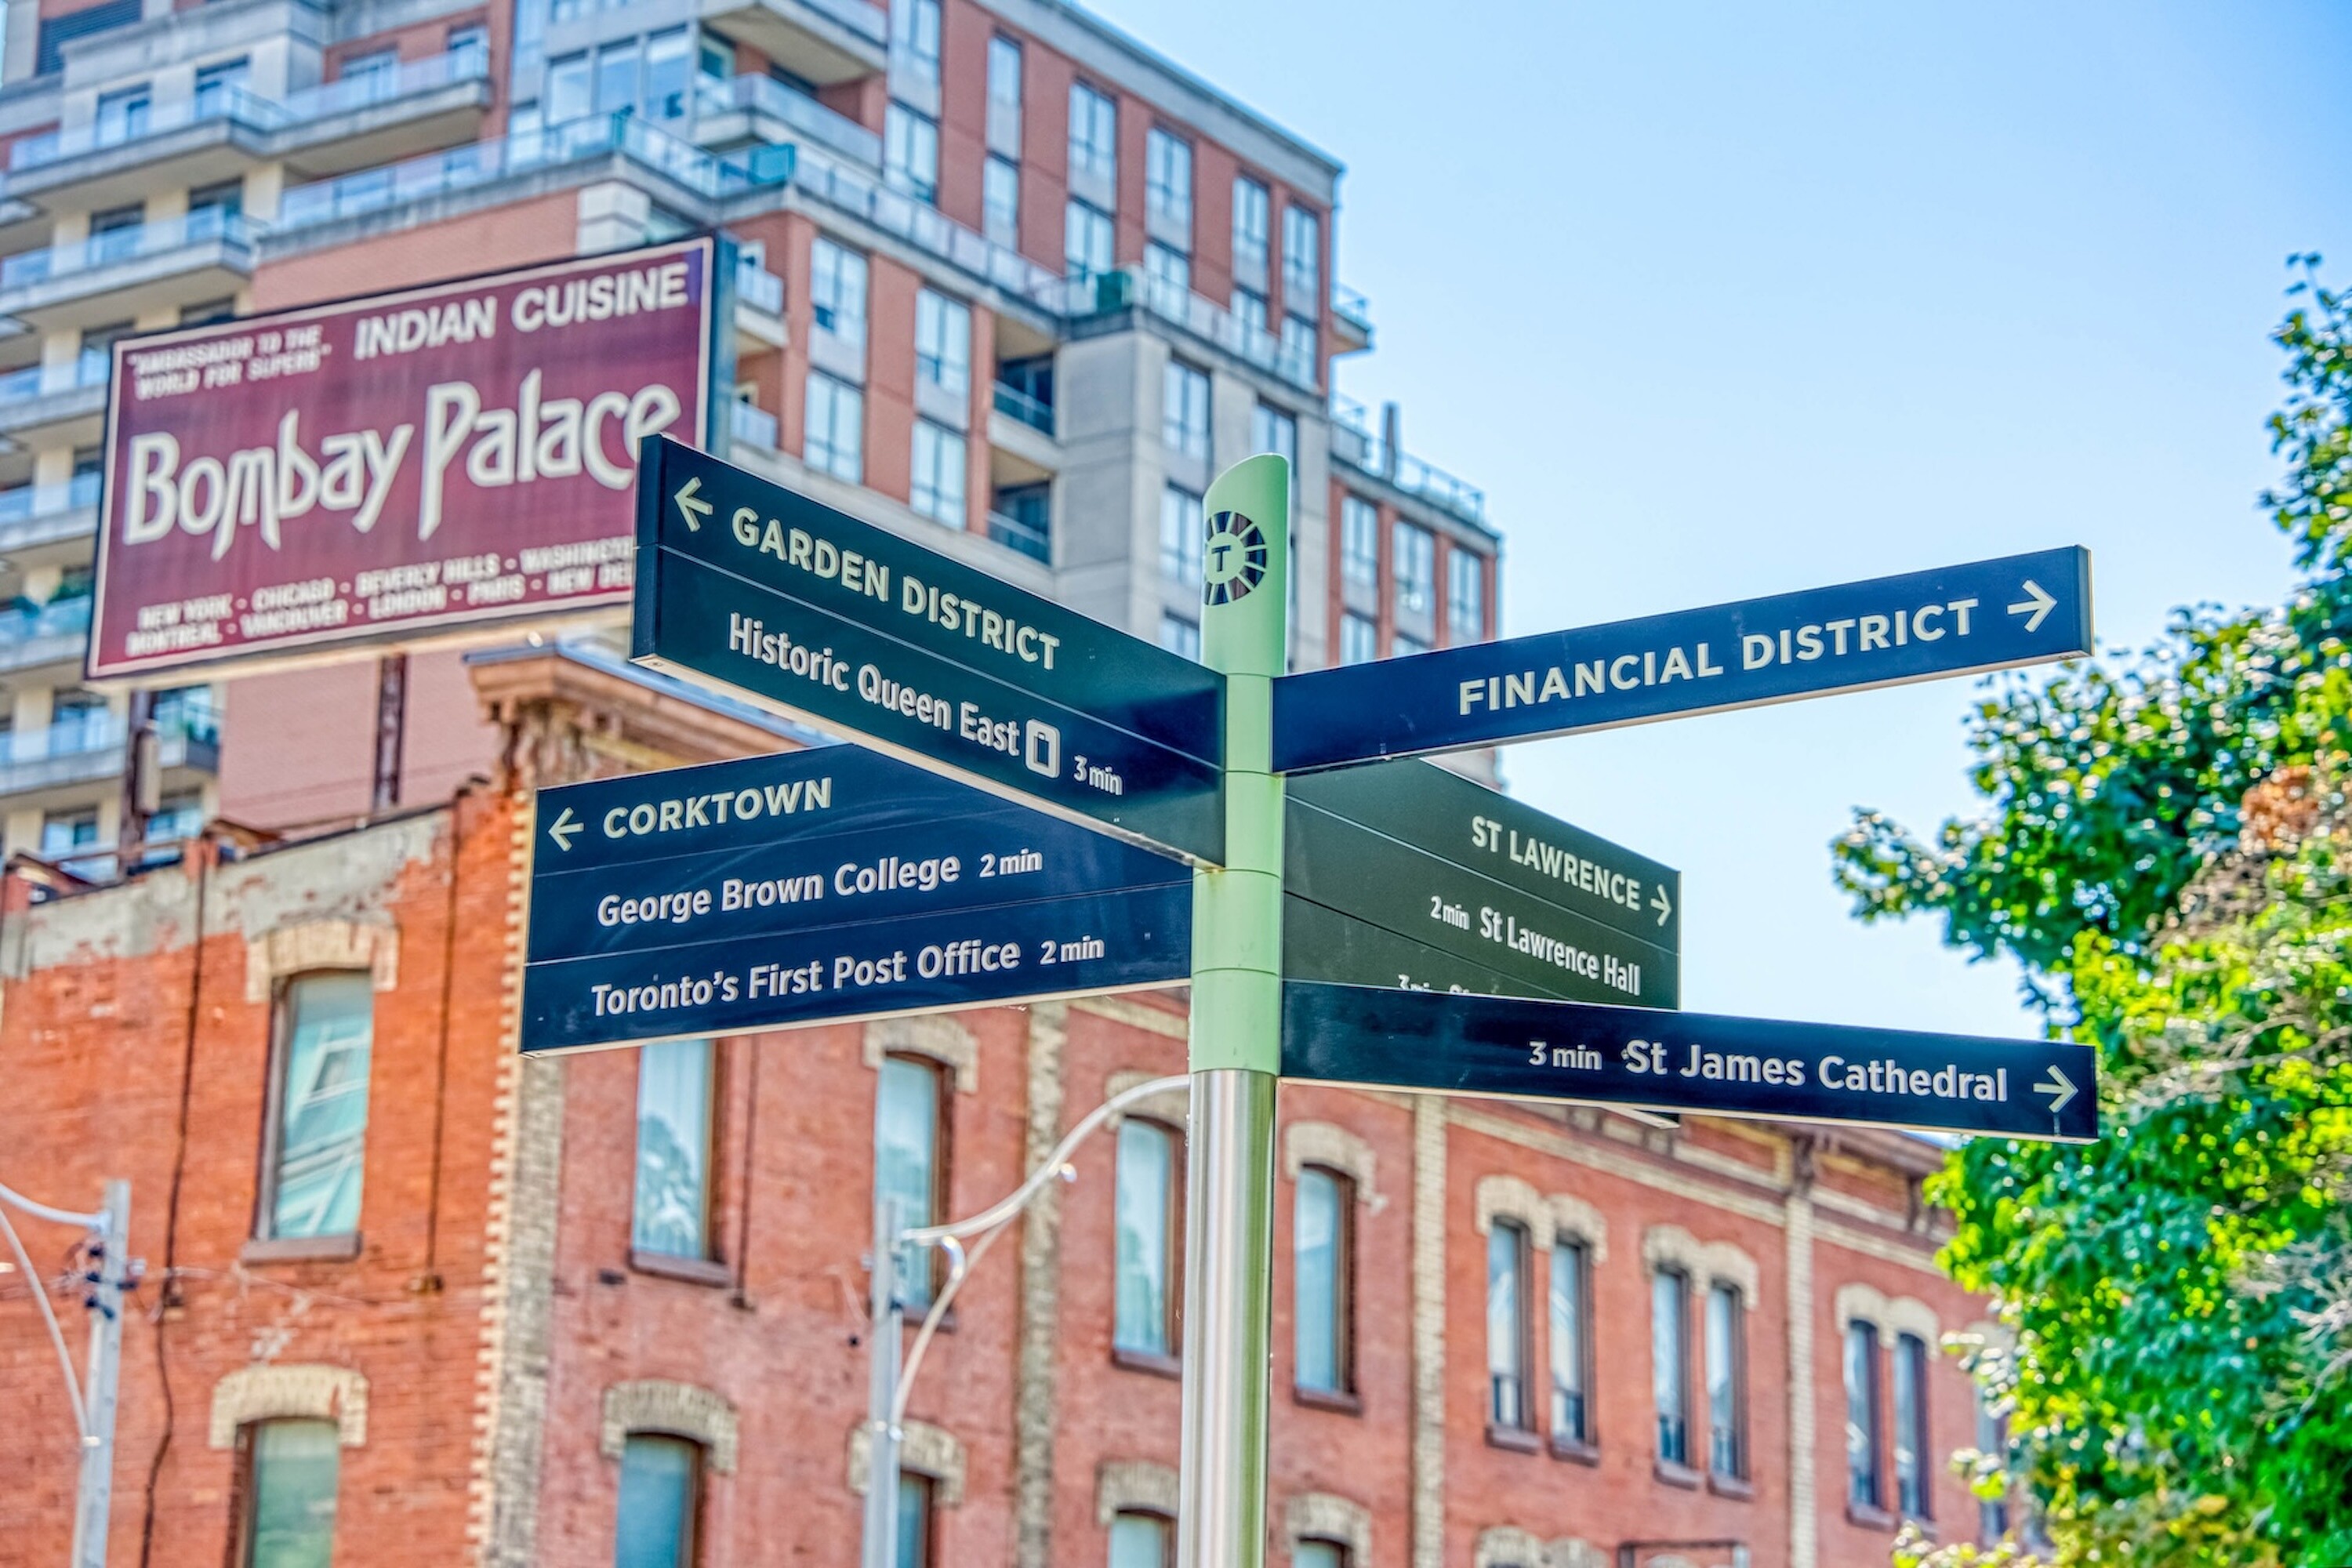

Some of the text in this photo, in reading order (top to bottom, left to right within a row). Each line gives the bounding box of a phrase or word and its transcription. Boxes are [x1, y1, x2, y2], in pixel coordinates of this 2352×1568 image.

[256, 331, 282, 355] TO
[284, 325, 323, 351] THE
[354, 262, 689, 360] INDIAN CUISINE
[134, 368, 201, 400] WORLD
[203, 361, 242, 389] FOR
[122, 367, 681, 562] Bombay Palace
[125, 622, 223, 657] MONTREAL
[240, 599, 349, 638] VANCOUVER
[368, 585, 447, 619] LONDON
[467, 573, 525, 605] PARIS
[547, 568, 594, 596] NEW
[137, 602, 183, 630] NEW
[183, 593, 233, 622] YORK
[252, 577, 336, 612] CHICAGO
[355, 561, 441, 597] BEVERLY
[442, 553, 501, 585] HILLS
[731, 506, 1060, 670] GARDEN DISTRICT
[729, 612, 1020, 756] Historic Queen East
[1458, 597, 1978, 716] FINANCIAL DISTRICT
[603, 777, 833, 839] CORKTOWN
[597, 848, 1043, 927] George Brown College 2 min
[1472, 815, 1641, 911] ST LAWRENCE
[748, 960, 823, 1000] First
[833, 951, 907, 989] Post
[917, 940, 1021, 978] Office
[1040, 941, 1056, 965] 2
[1060, 935, 1105, 962] min
[1479, 906, 1502, 942] St
[1507, 916, 1599, 980] Lawrence
[1603, 954, 1641, 996] Hall
[1528, 1040, 2007, 1102] 3 min St James Cathedral
